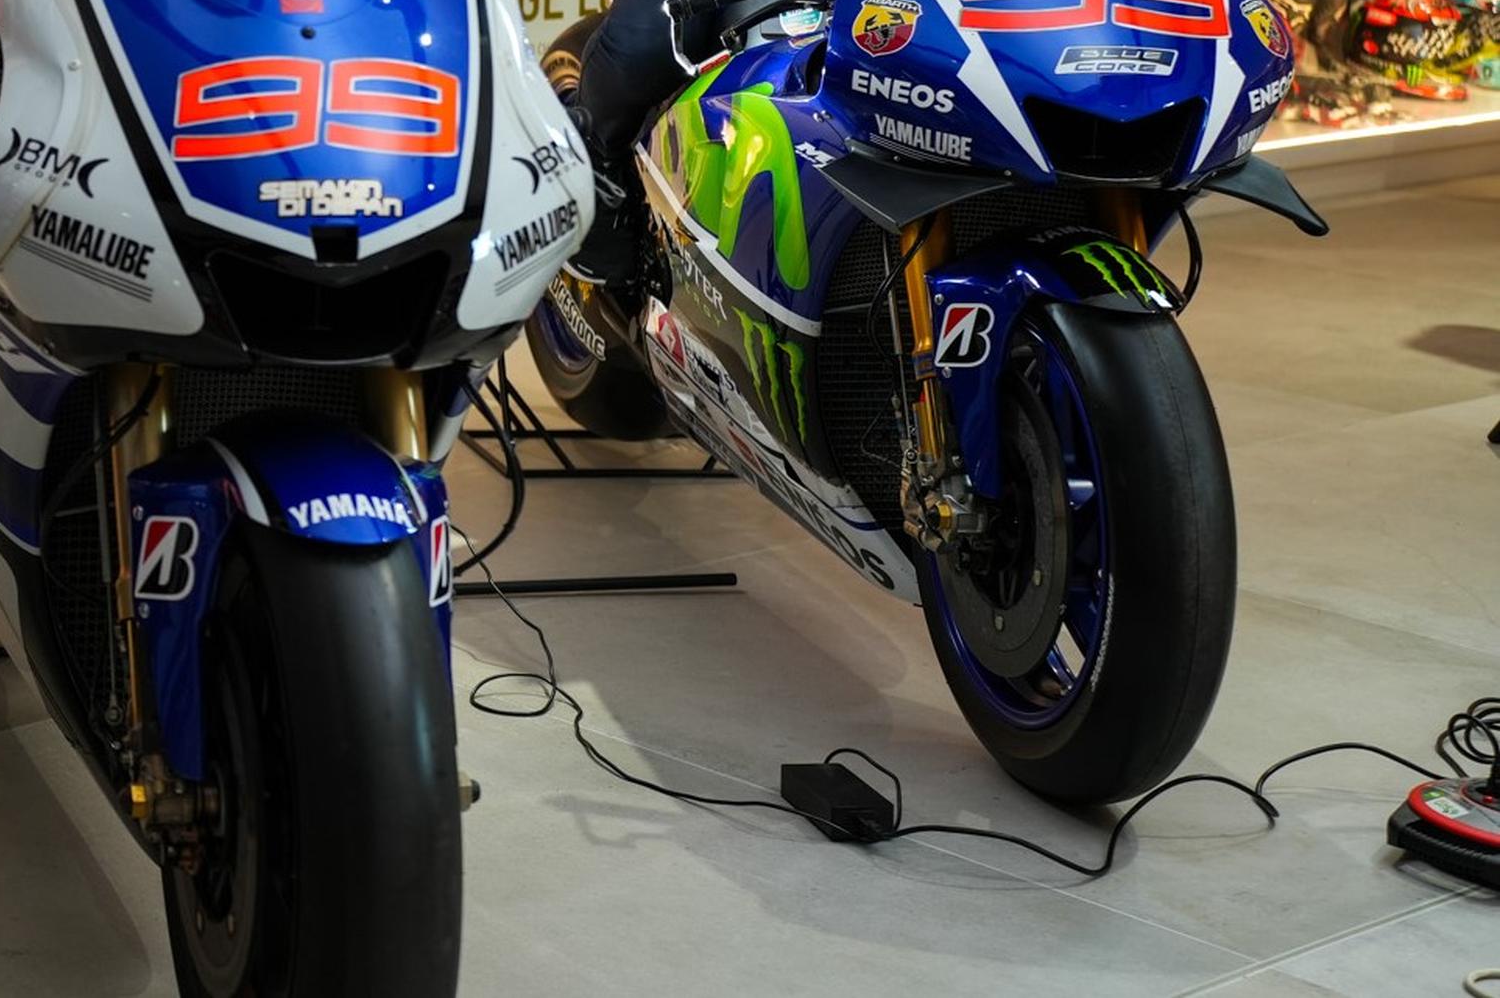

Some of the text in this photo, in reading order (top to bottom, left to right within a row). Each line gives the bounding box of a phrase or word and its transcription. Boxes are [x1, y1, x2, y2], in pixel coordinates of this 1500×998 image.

[1073, 60, 1162, 72] CORE
[1079, 48, 1164, 60] BLUE
[171, 55, 461, 162] 99
[851, 68, 956, 114] ENEOS
[874, 112, 973, 162] YAMALUBE
[30, 204, 155, 280] YAMALUBE
[493, 198, 579, 272] YAMALUBE
[288, 492, 412, 529] YAMAHA
